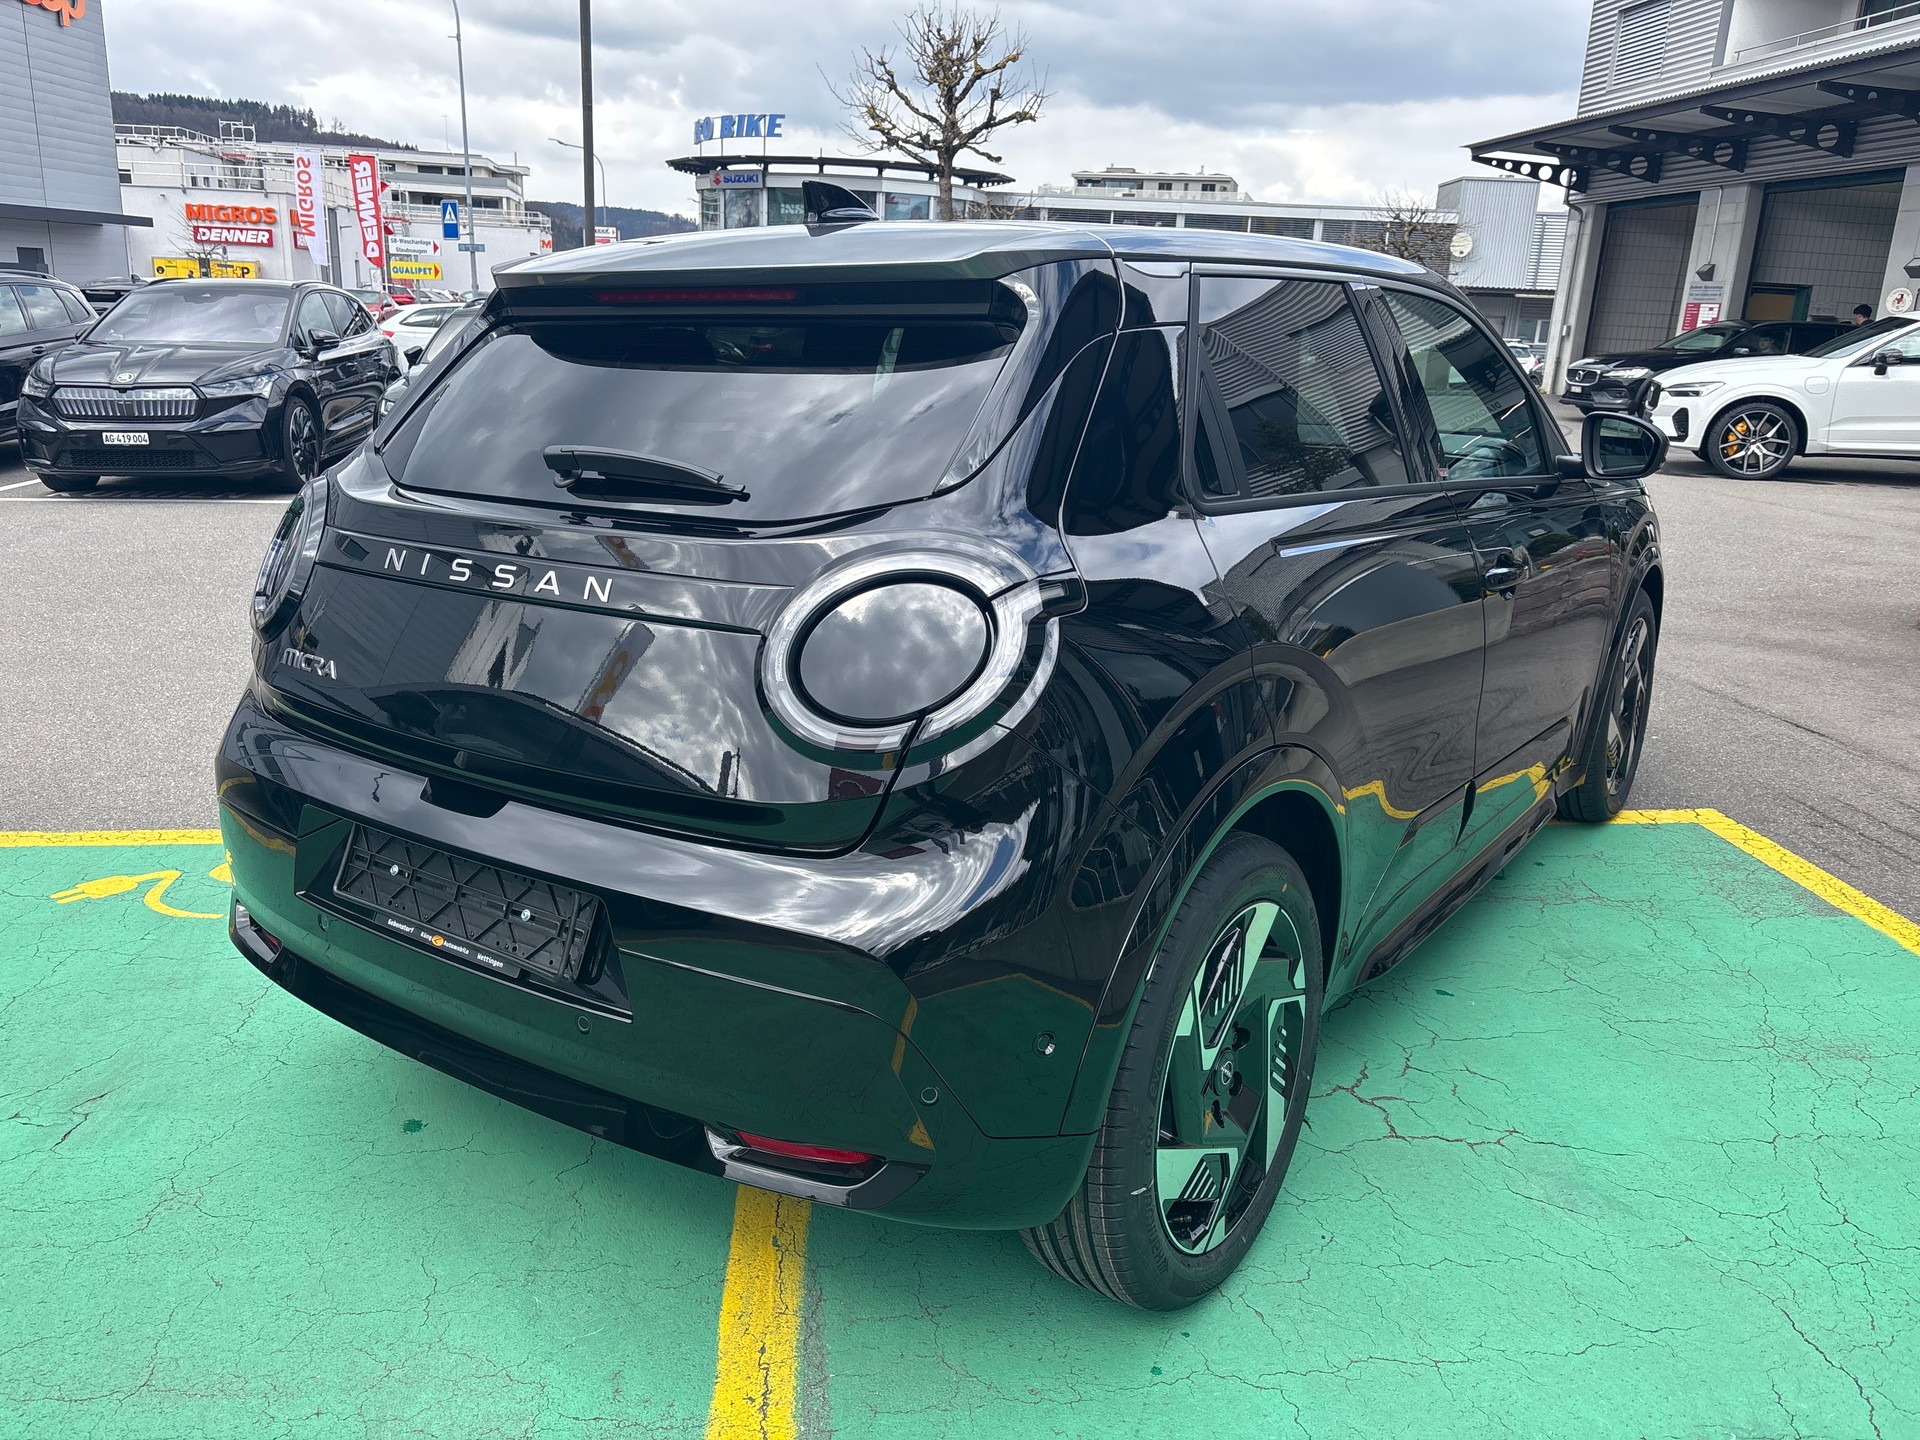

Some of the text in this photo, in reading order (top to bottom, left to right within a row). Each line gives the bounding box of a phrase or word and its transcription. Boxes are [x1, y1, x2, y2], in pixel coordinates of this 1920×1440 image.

[720, 114, 785, 138] BIKE
[723, 174, 759, 184] SUZUKI
[185, 203, 277, 225] MIGROS
[197, 228, 270, 244] DENNER
[390, 238, 432, 246] SB-Waschanlage
[395, 247, 428, 255] Staubsaugen
[392, 266, 433, 275] QUALIPET
[384, 548, 613, 602] NISSAN
[282, 647, 338, 680] MICRA
[387, 919, 414, 934] Gebenstorf
[443, 941, 470, 955] Automobile
[477, 953, 504, 968] Wettingen
